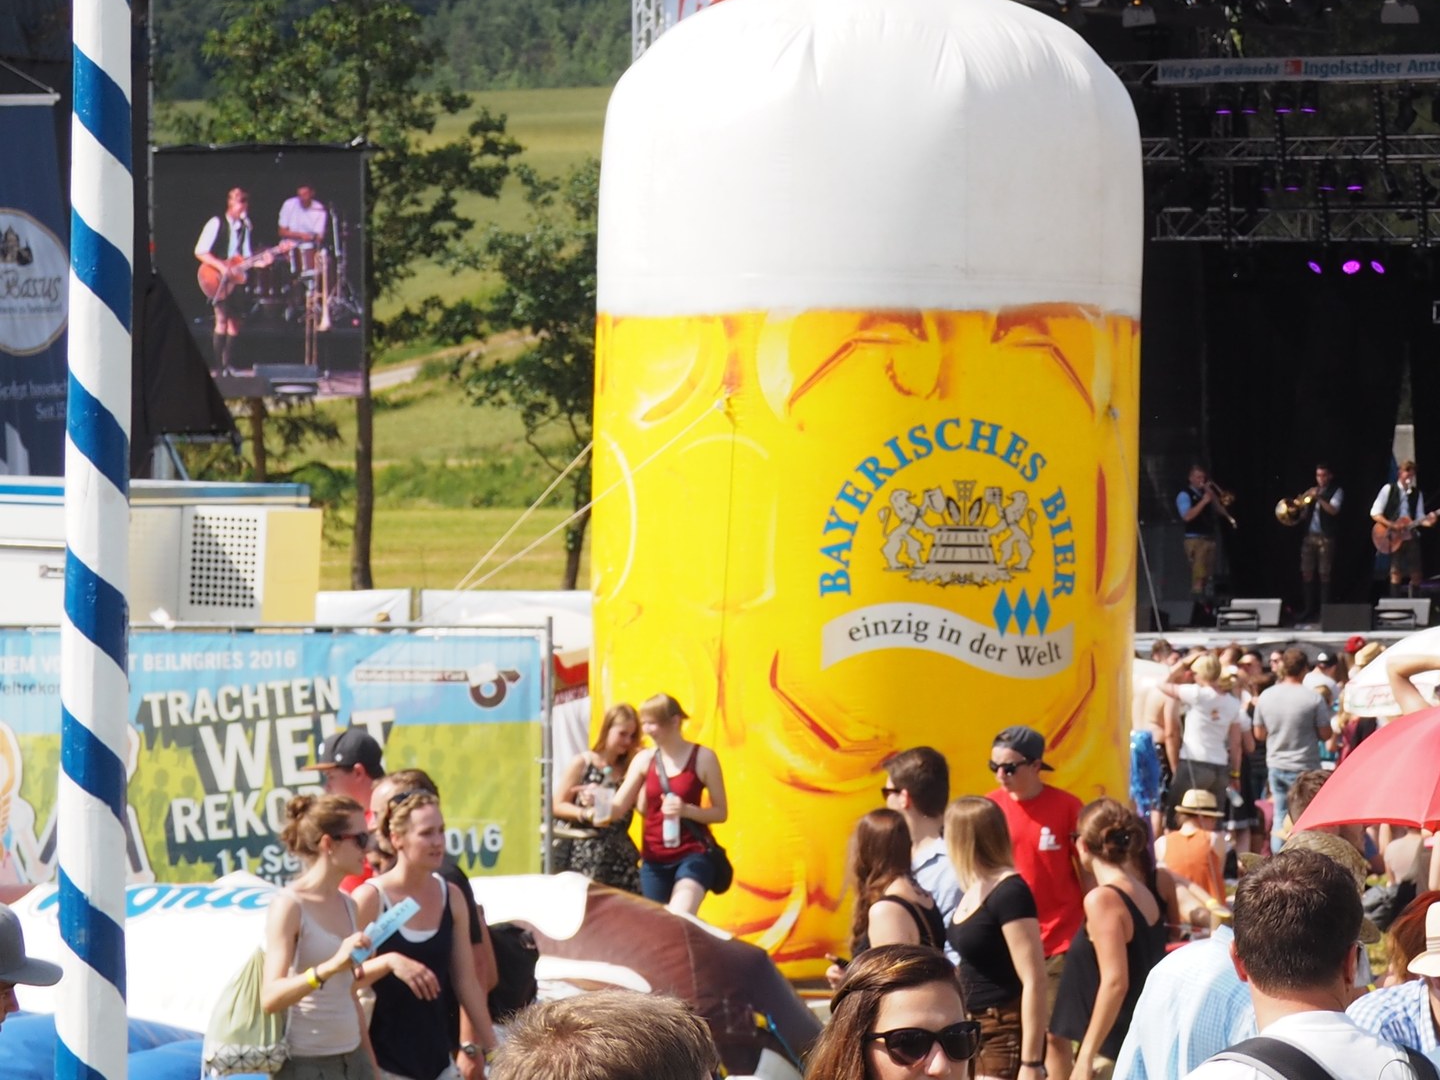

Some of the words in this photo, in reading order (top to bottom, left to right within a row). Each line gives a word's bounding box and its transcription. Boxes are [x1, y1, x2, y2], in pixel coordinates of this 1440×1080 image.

[1161, 66, 1186, 78] Viel
[1188, 64, 1221, 80] Spaß
[1223, 63, 1279, 76] wünscht
[1304, 59, 1402, 78] Ingolstädter
[818, 417, 1047, 597] BAYERISCHES
[1040, 486, 1076, 599] BIER
[143, 651, 244, 671] BEILNGRIES
[250, 650, 297, 669] 2016
[848, 612, 930, 643] einzig
[936, 618, 963, 645] in
[968, 633, 1008, 663] der
[1015, 642, 1063, 667] Welt
[143, 676, 341, 729] TRACHTEN
[444, 824, 504, 856] 016
